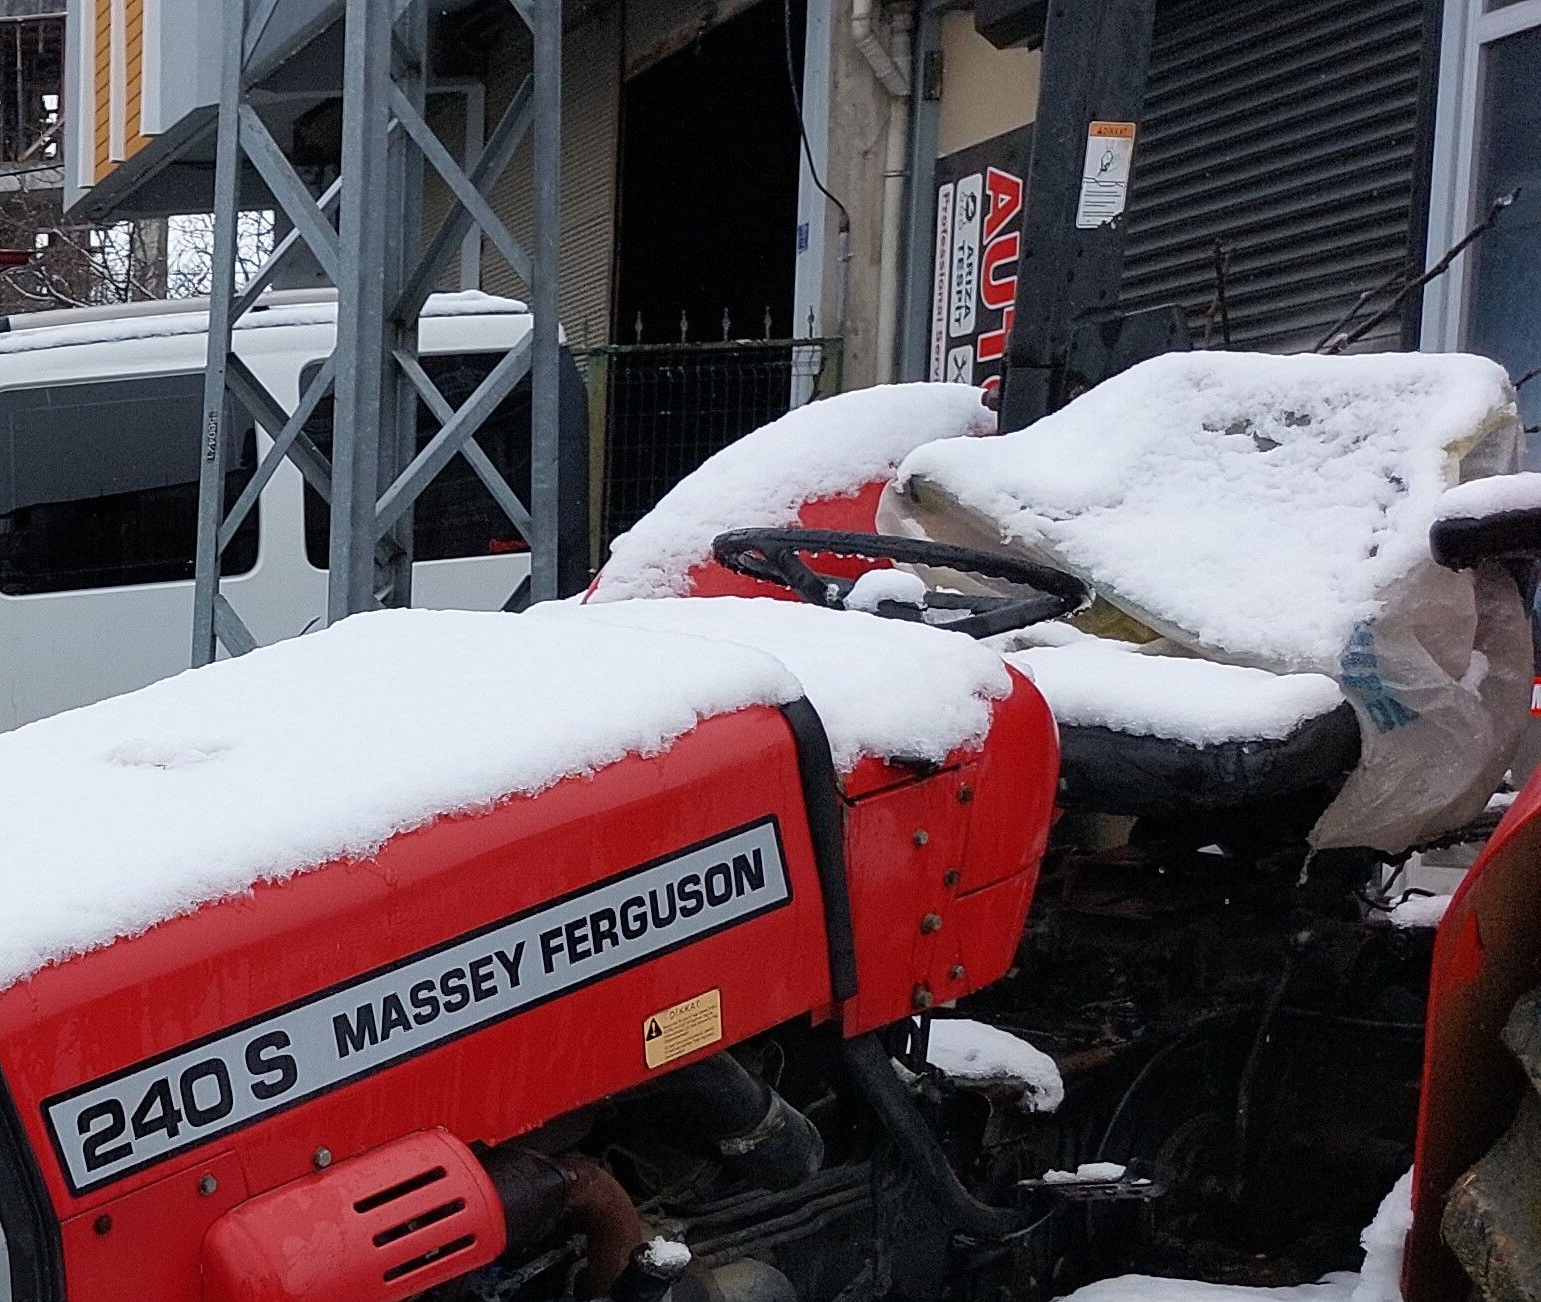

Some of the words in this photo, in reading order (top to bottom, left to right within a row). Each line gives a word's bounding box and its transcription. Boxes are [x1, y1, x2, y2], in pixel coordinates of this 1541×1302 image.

[977, 167, 1023, 388] AUT
[77, 1057, 233, 1172] 240
[245, 1030, 298, 1100] S
[332, 940, 526, 1059] MASSEY
[539, 847, 766, 974] FERGUSON
